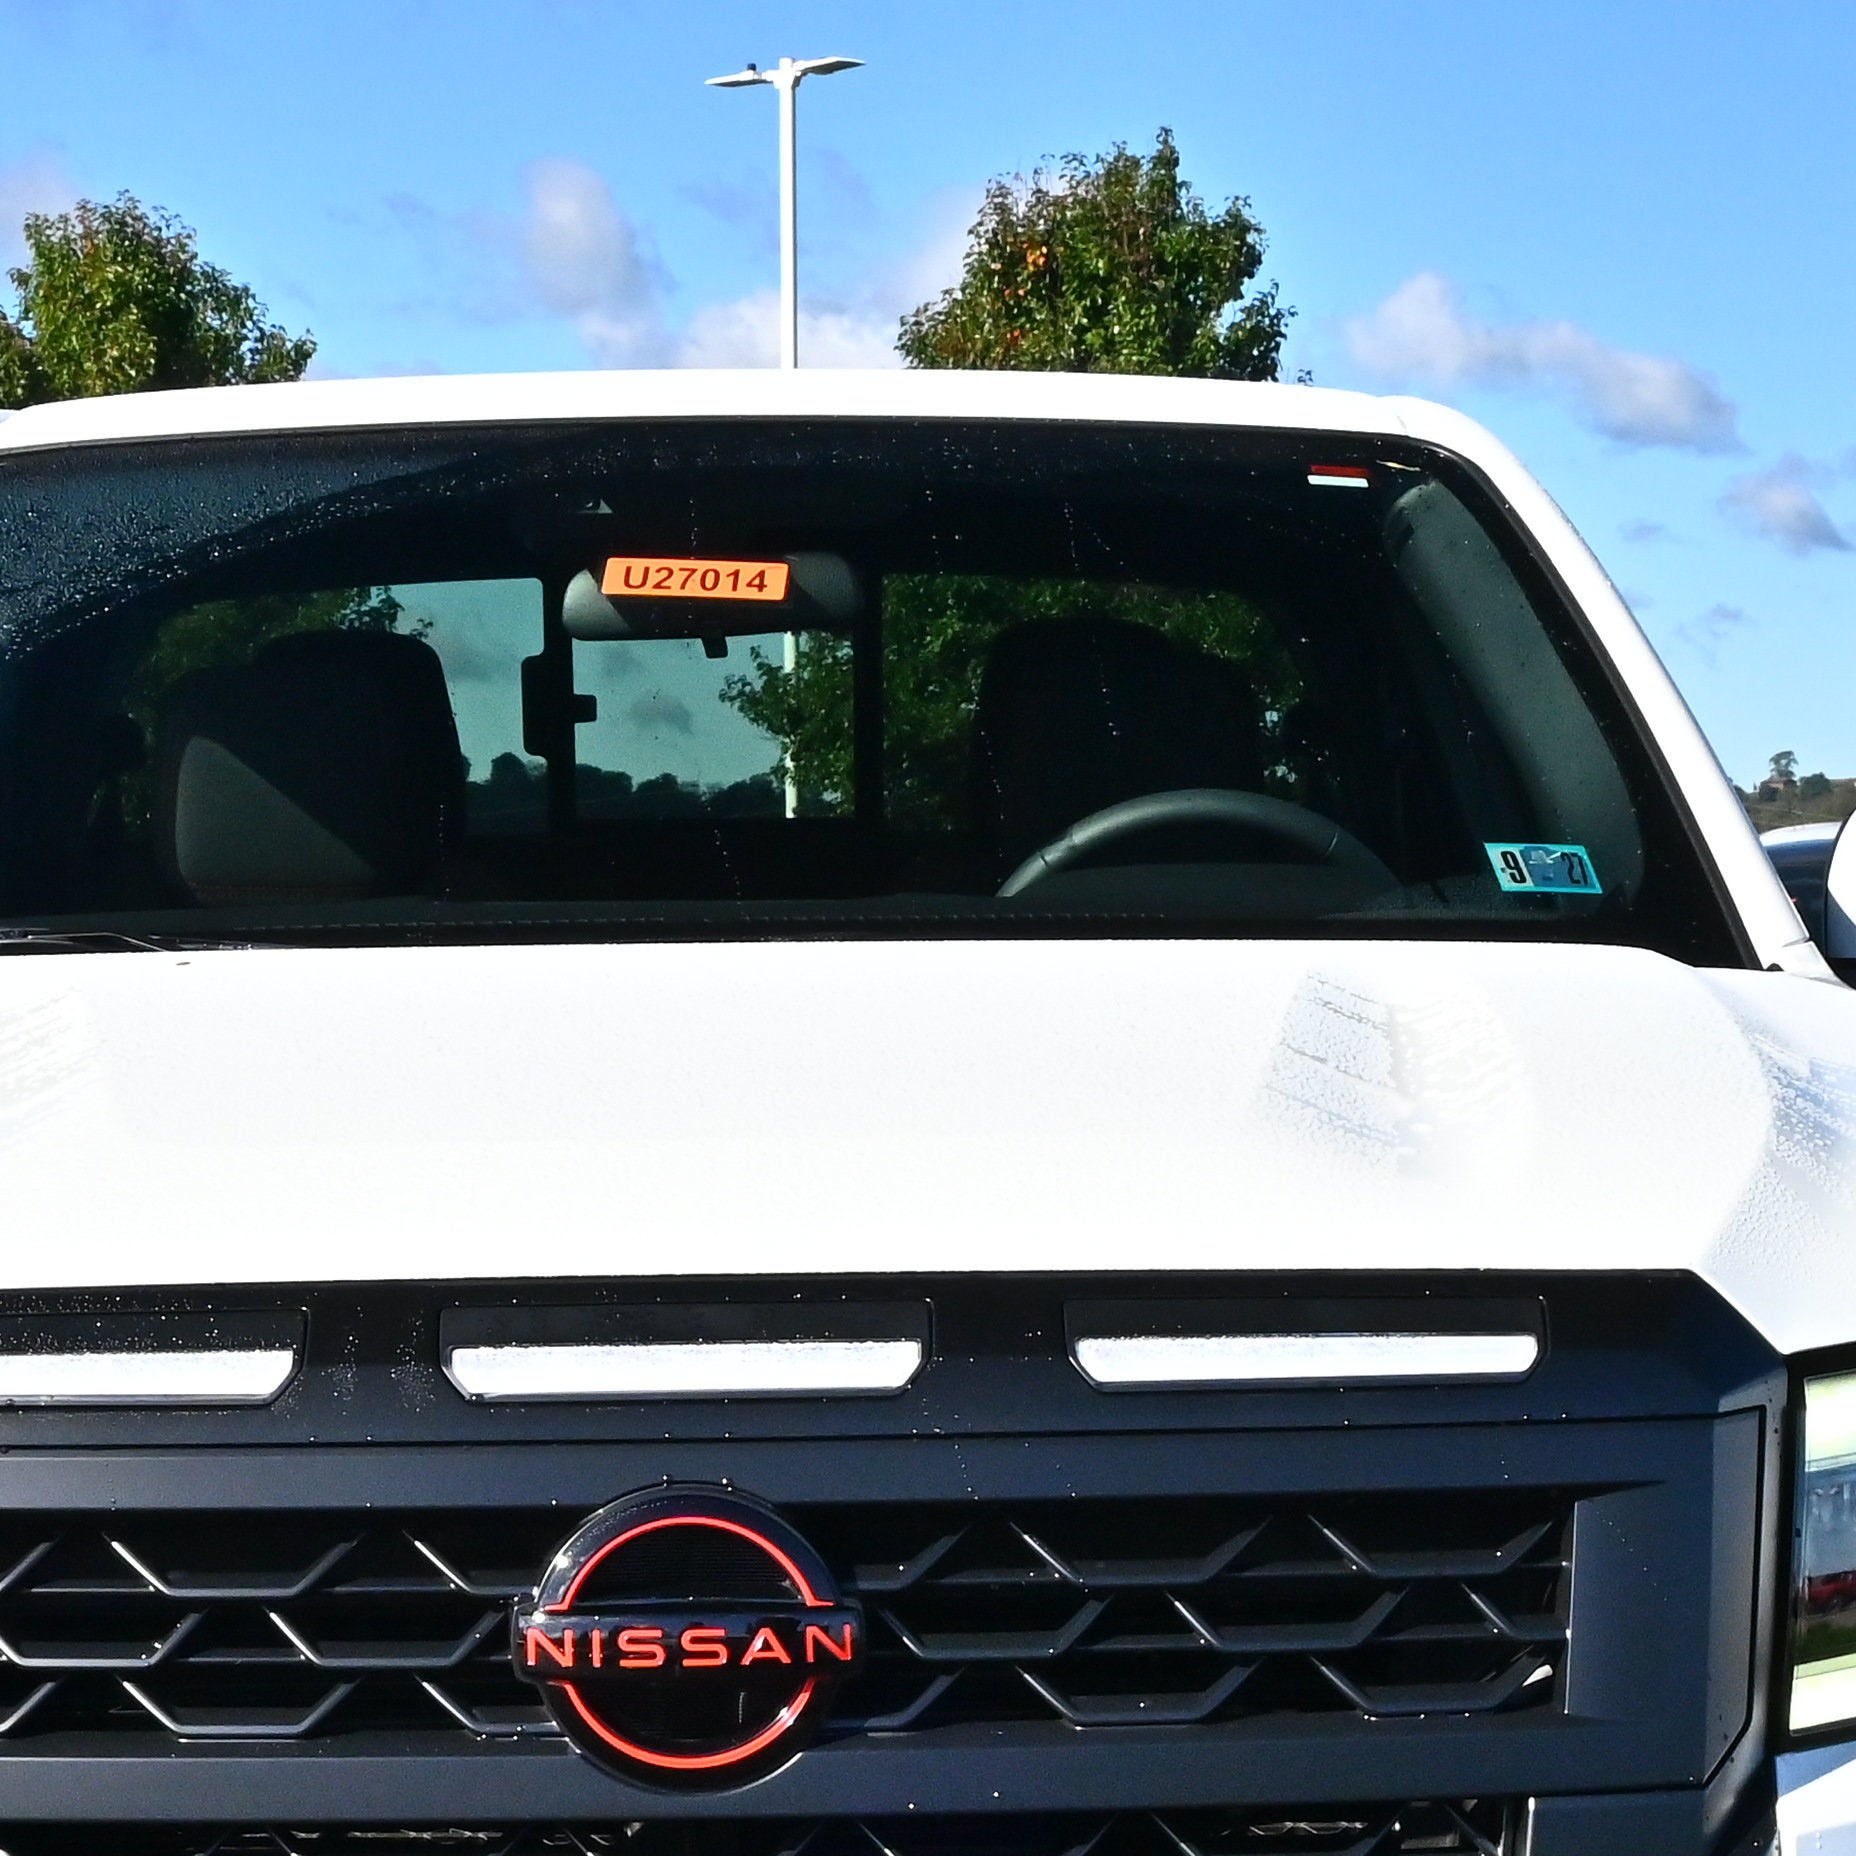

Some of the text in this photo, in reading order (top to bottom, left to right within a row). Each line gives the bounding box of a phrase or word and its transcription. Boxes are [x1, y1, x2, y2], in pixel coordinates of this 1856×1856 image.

[623, 565, 768, 592] U27014
[1500, 850, 1588, 885] 9 27
[525, 1623, 853, 1669] NISSAN
